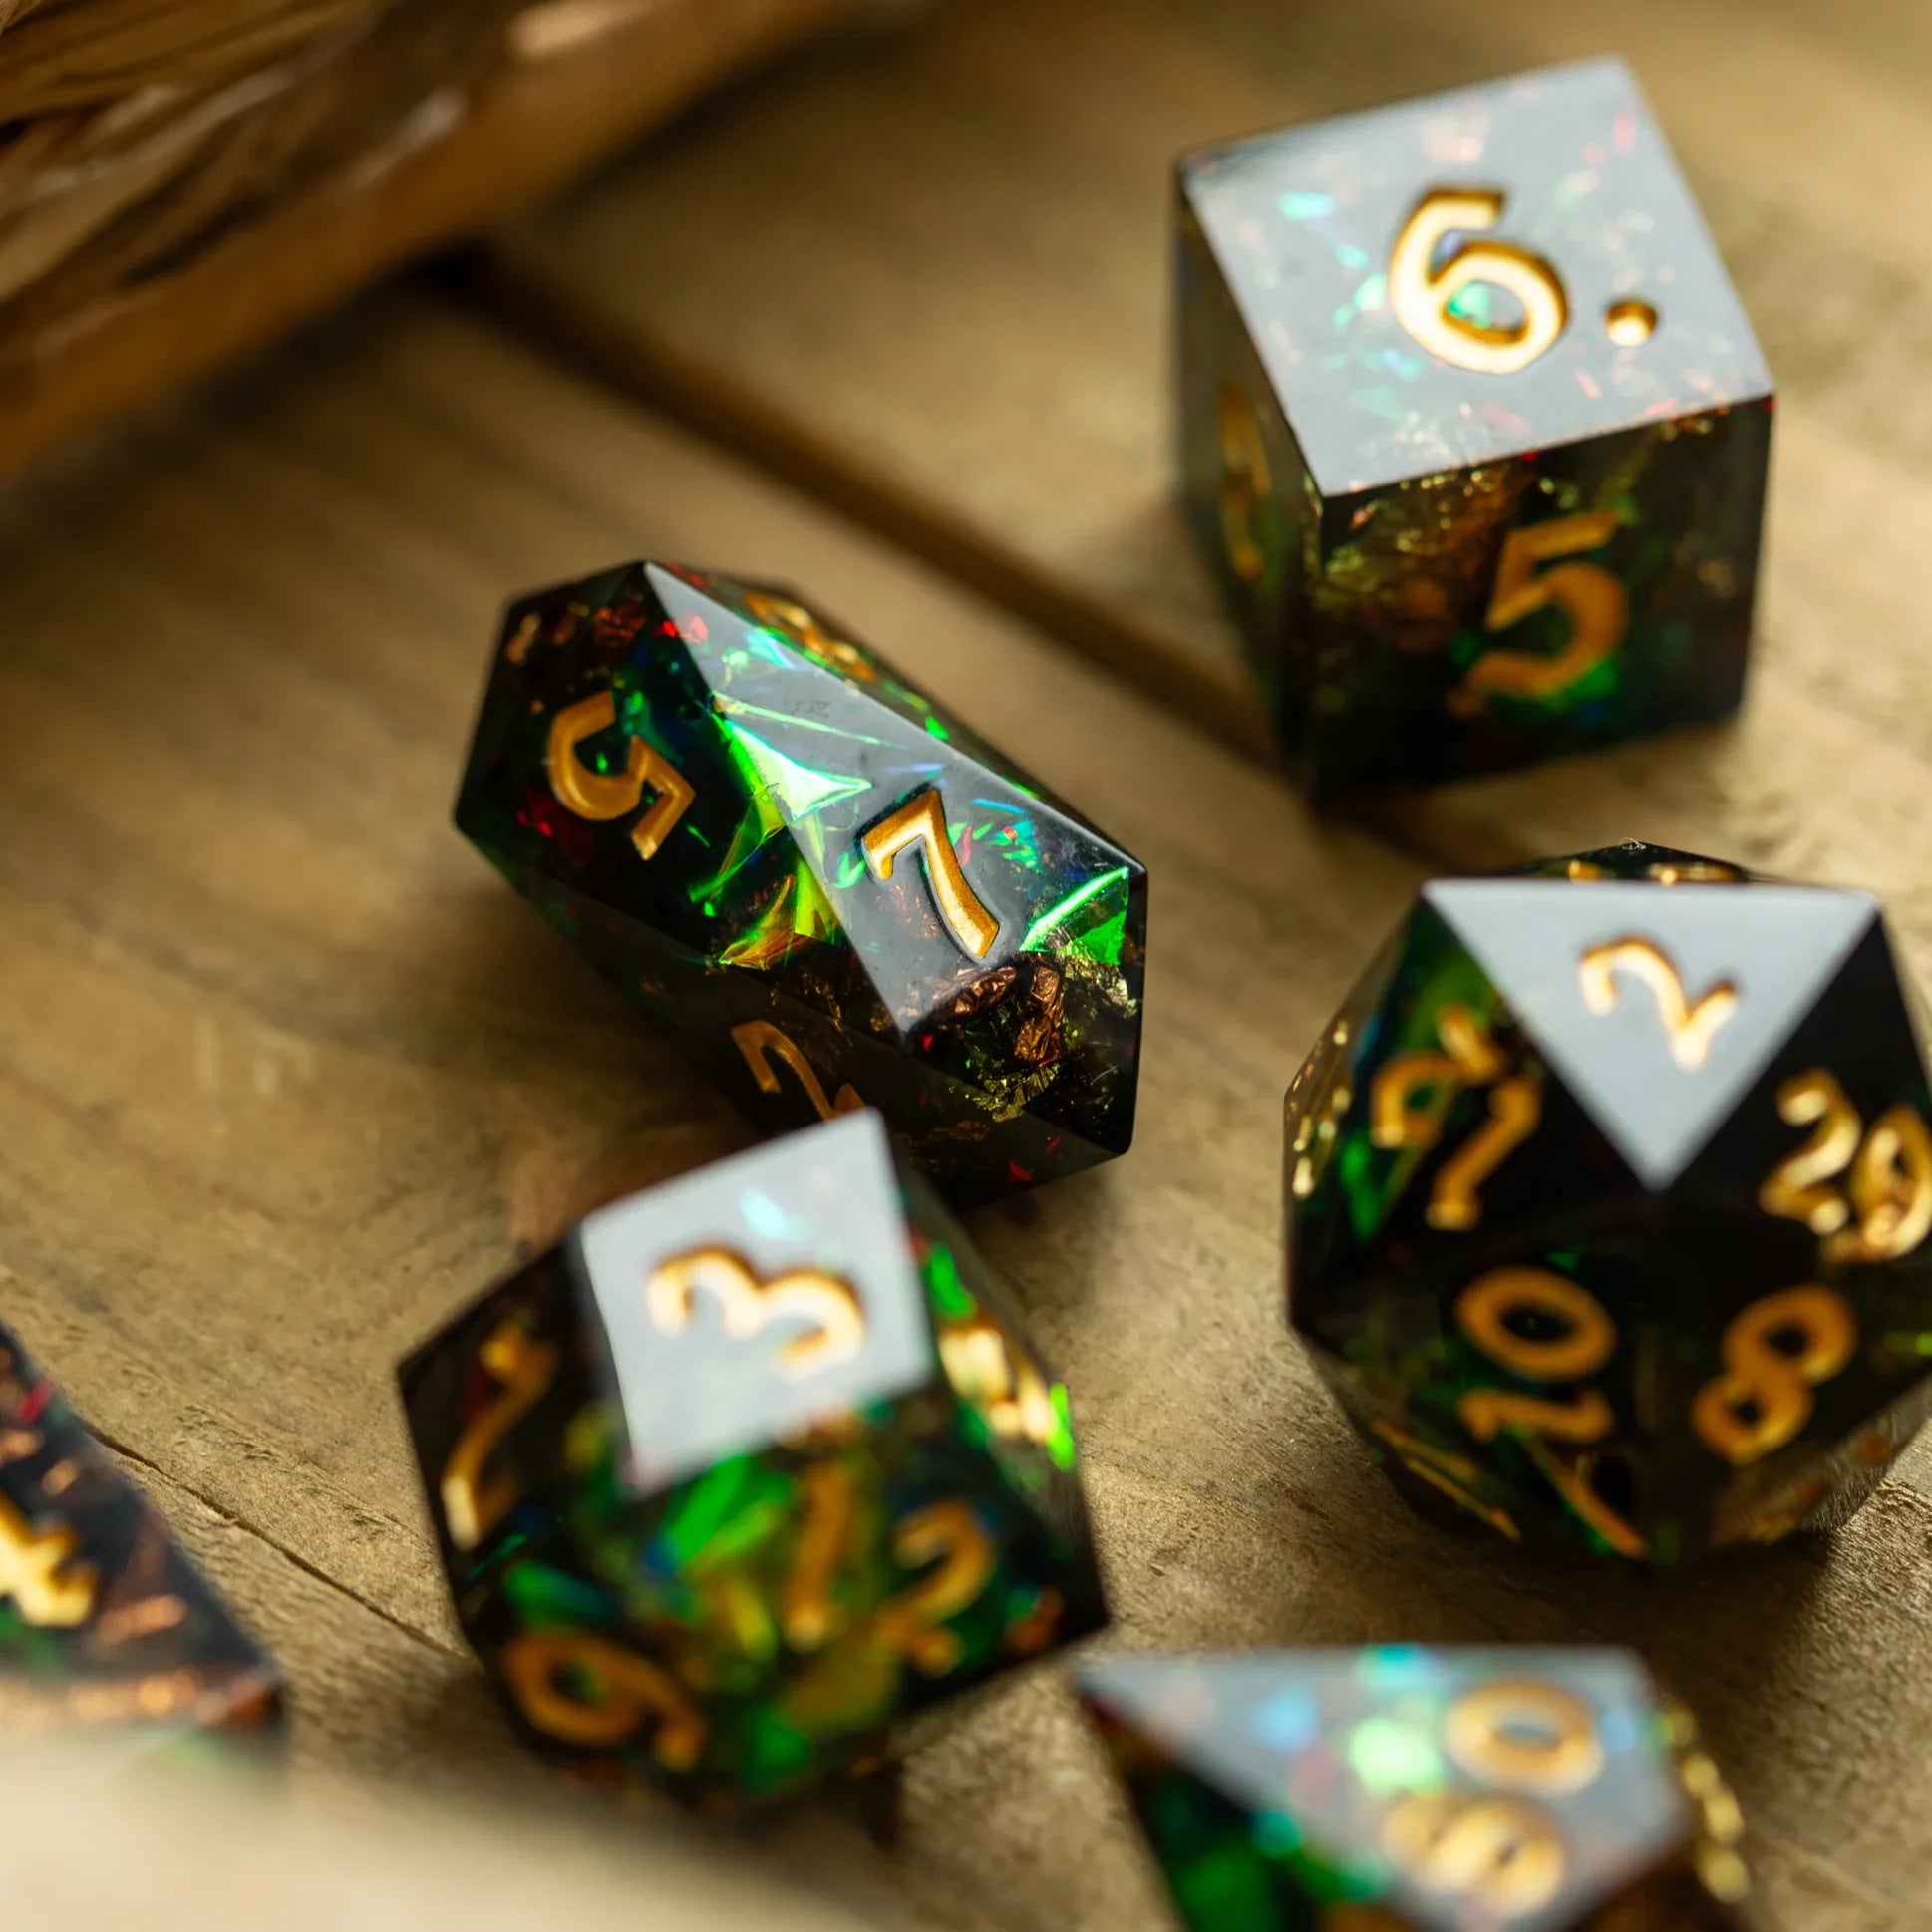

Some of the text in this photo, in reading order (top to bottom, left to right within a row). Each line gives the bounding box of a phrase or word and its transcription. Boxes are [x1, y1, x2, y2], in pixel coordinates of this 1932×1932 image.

[1448, 508, 1629, 718] 5
[546, 690, 696, 862] 5
[861, 788, 1000, 961] 7
[1578, 934, 1742, 1071] 2
[644, 1242, 867, 1385] 3
[1692, 1282, 1857, 1466] 8
